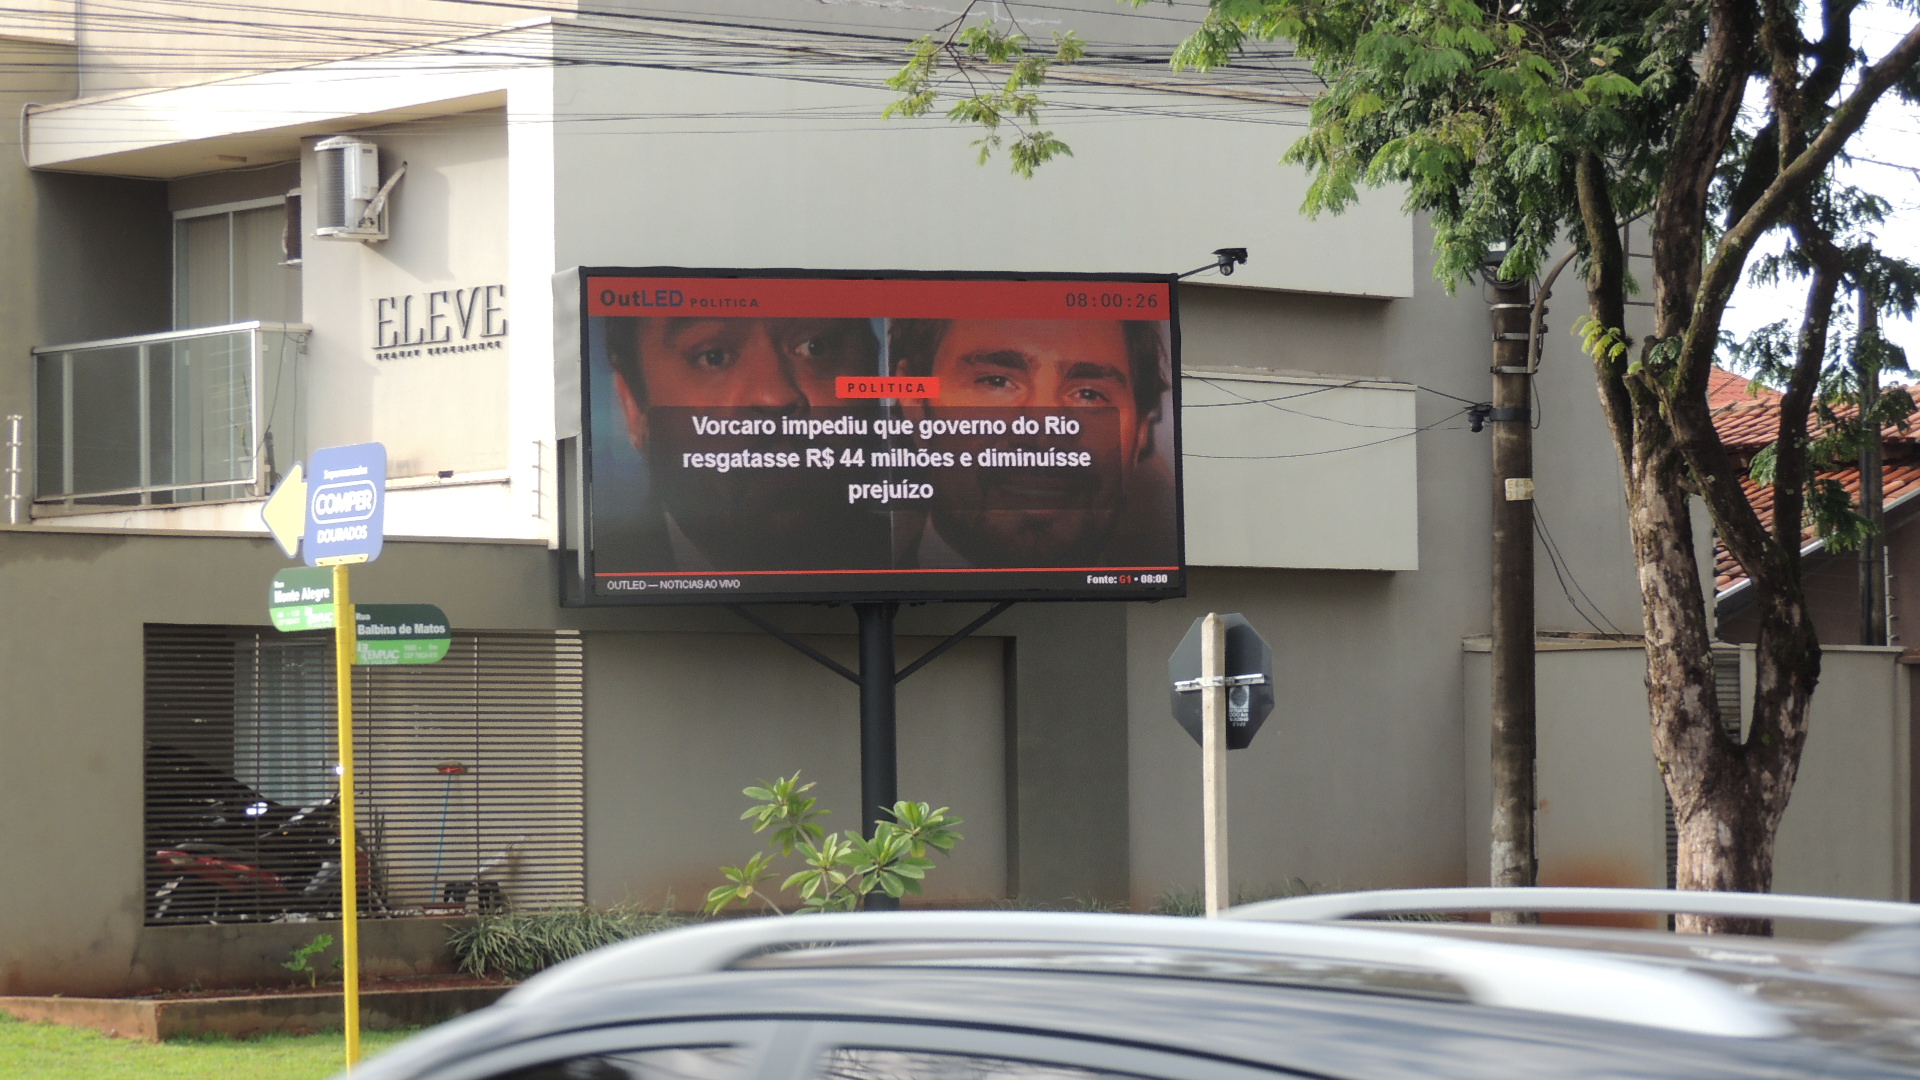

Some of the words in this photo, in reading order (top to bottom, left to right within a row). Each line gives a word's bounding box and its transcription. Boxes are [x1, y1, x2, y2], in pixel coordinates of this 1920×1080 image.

[601, 289, 684, 307] OutLED
[690, 298, 759, 308] POLITICA
[1065, 292, 1158, 309] 08:00:26
[371, 285, 507, 349] ELEVE
[848, 382, 926, 393] POLITICA
[692, 415, 776, 435] Vorcaro
[782, 415, 868, 440] impediu
[873, 419, 914, 440] que
[919, 419, 1007, 440] governo
[1011, 415, 1039, 435] do
[1044, 415, 1080, 435] Rio
[682, 449, 800, 473] resgatasse
[806, 446, 835, 470] R$
[839, 448, 865, 468] 44
[870, 448, 955, 468] milhões
[959, 451, 973, 467] e
[977, 446, 1092, 468] diminuísse
[848, 479, 934, 504] prejuízo
[316, 490, 372, 515] COMPER
[317, 525, 368, 543] DOURADOS
[607, 580, 646, 590] OUTLED
[704, 580, 718, 589] AO
[719, 579, 741, 589] VIVO
[1086, 575, 1117, 584] Fonte:
[1119, 574, 1132, 584] G1
[1140, 574, 1168, 583] 08:00
[274, 589, 300, 604] Monte
[301, 587, 330, 602] Alegre
[356, 612, 371, 621] Rua
[357, 623, 396, 635] Balbina
[399, 623, 412, 635] de
[414, 623, 446, 634] Matos
